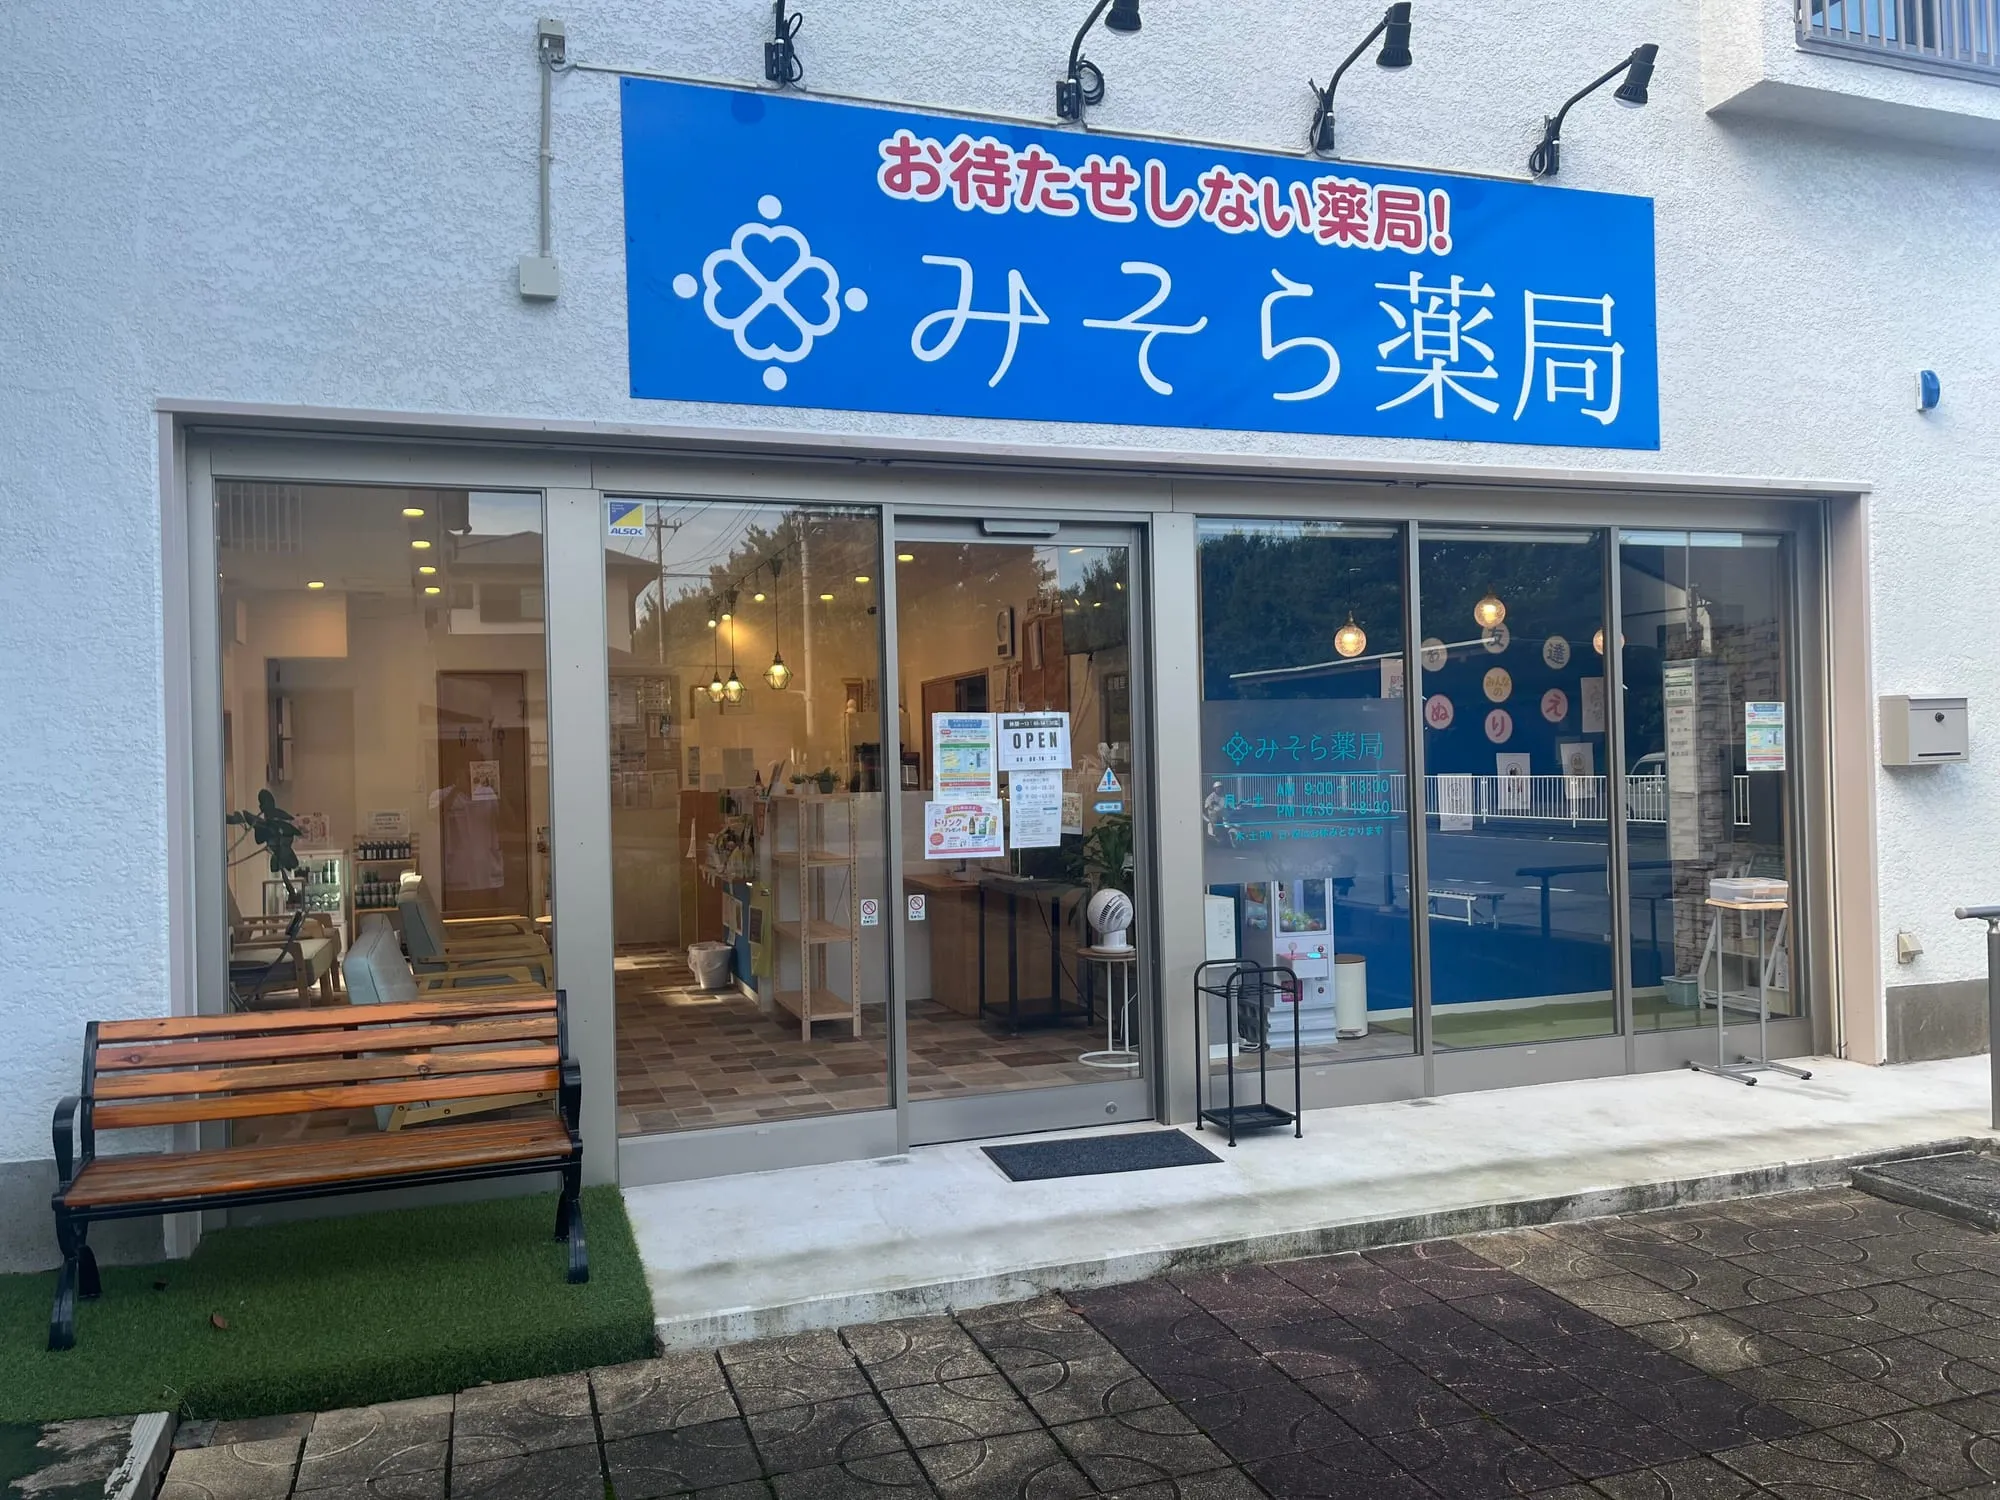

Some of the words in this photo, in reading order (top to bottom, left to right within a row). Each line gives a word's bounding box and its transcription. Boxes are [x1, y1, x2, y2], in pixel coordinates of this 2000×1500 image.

[911, 254, 1625, 425] みそら薬局
[610, 527, 643, 536] ALSOK
[1013, 732, 1058, 749] OPEN
[1254, 731, 1384, 762] みそら薬局
[1276, 782, 1296, 797] AM
[1276, 803, 1295, 818] PM
